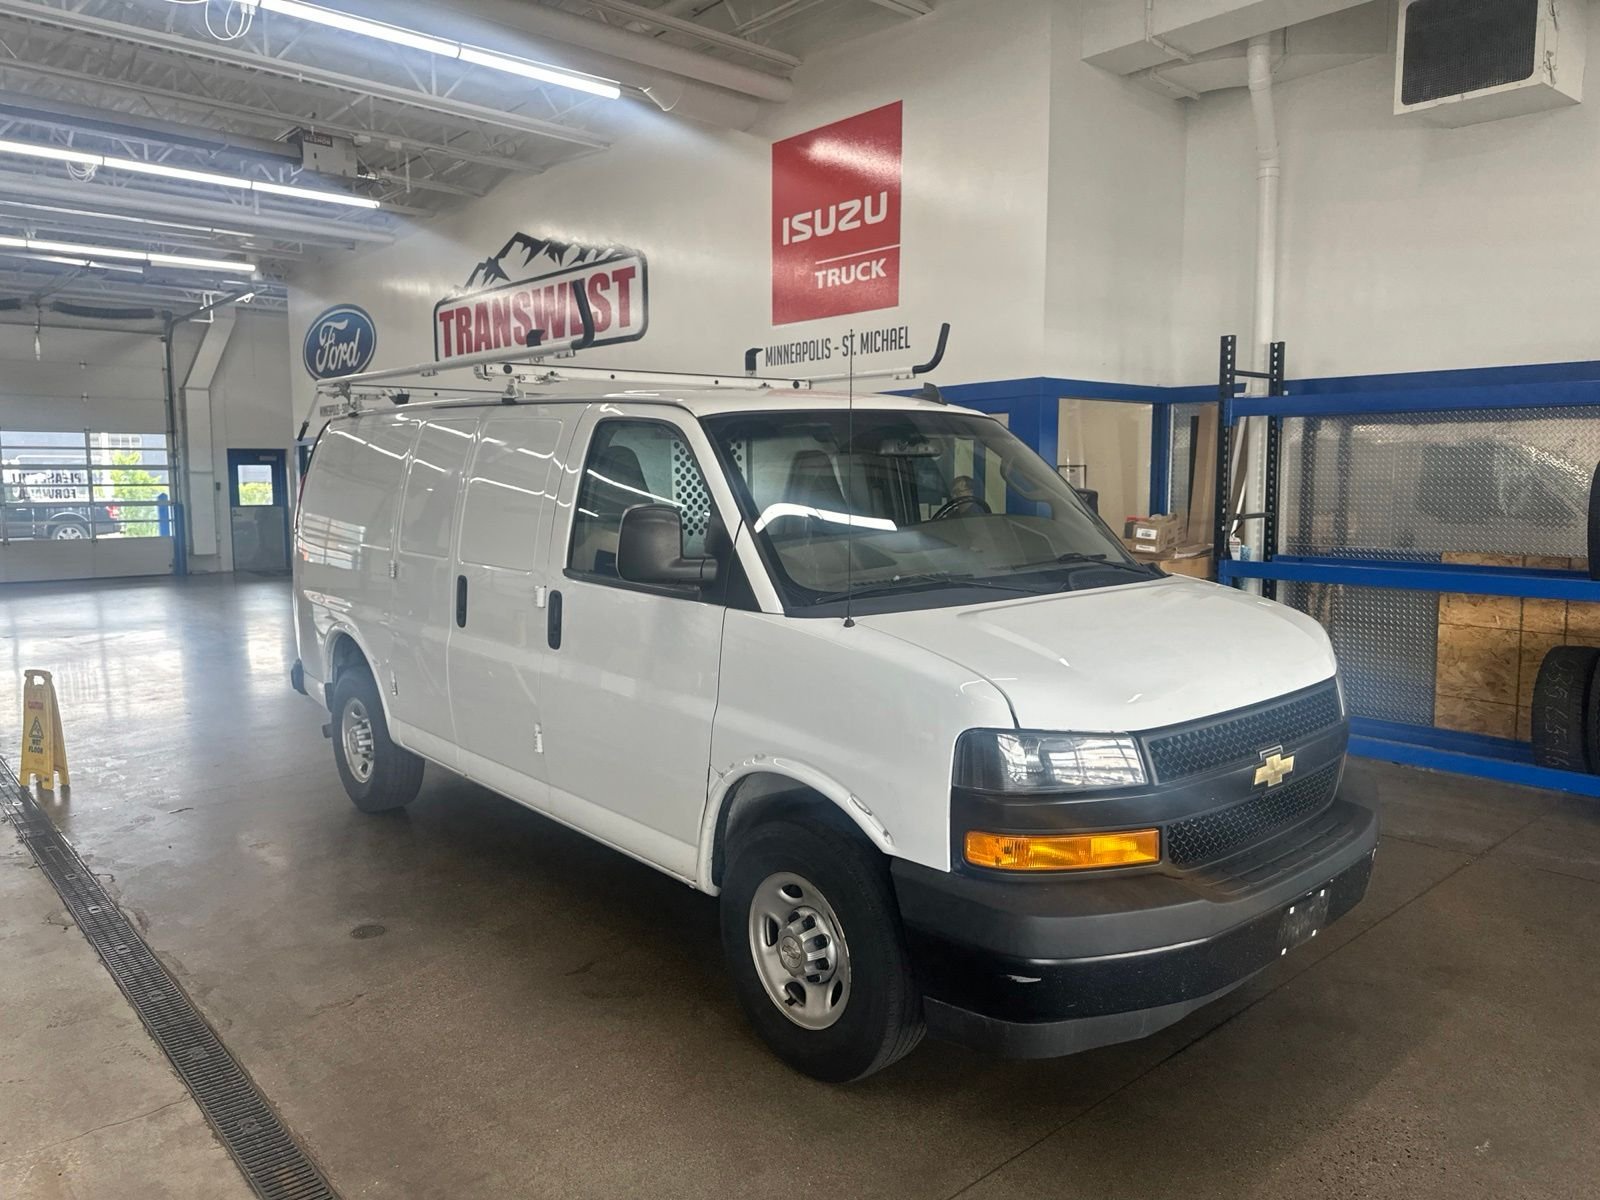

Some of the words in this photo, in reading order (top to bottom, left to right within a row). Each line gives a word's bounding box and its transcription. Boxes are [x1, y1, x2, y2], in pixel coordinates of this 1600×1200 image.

[782, 191, 888, 246] ISUZU
[815, 258, 887, 289] TRUCK
[315, 319, 361, 373] Ford
[765, 337, 831, 367] MINNEAPOLIS
[860, 326, 911, 354] MICHAEL
